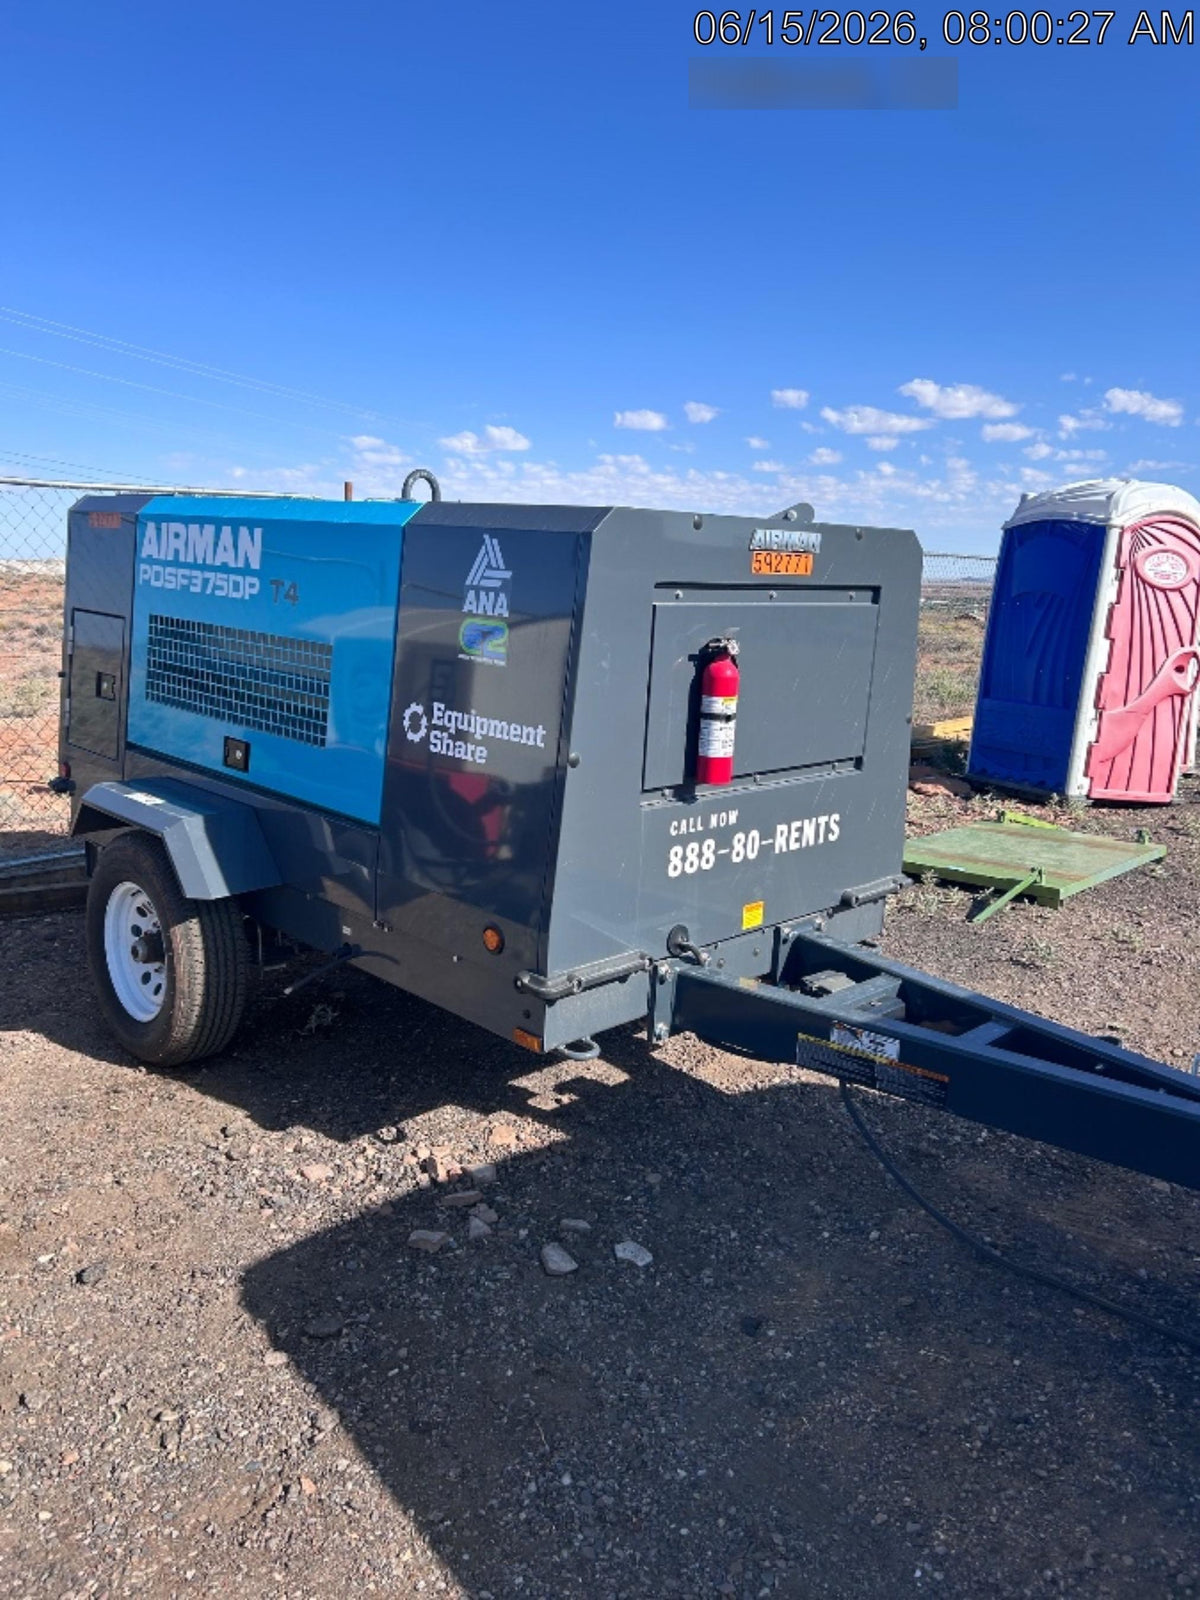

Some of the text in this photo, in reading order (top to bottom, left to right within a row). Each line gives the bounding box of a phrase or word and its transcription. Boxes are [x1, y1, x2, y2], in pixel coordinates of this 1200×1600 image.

[141, 521, 263, 569] AIRMAN
[749, 528, 822, 554] AIRMAN
[753, 552, 809, 573] 592771
[269, 578, 300, 605] T4
[462, 589, 509, 618] ANA
[431, 701, 546, 748] Equipment
[429, 730, 488, 764] Share
[669, 809, 739, 836] CALL NOW
[667, 812, 841, 878] 888-80-RENTS
